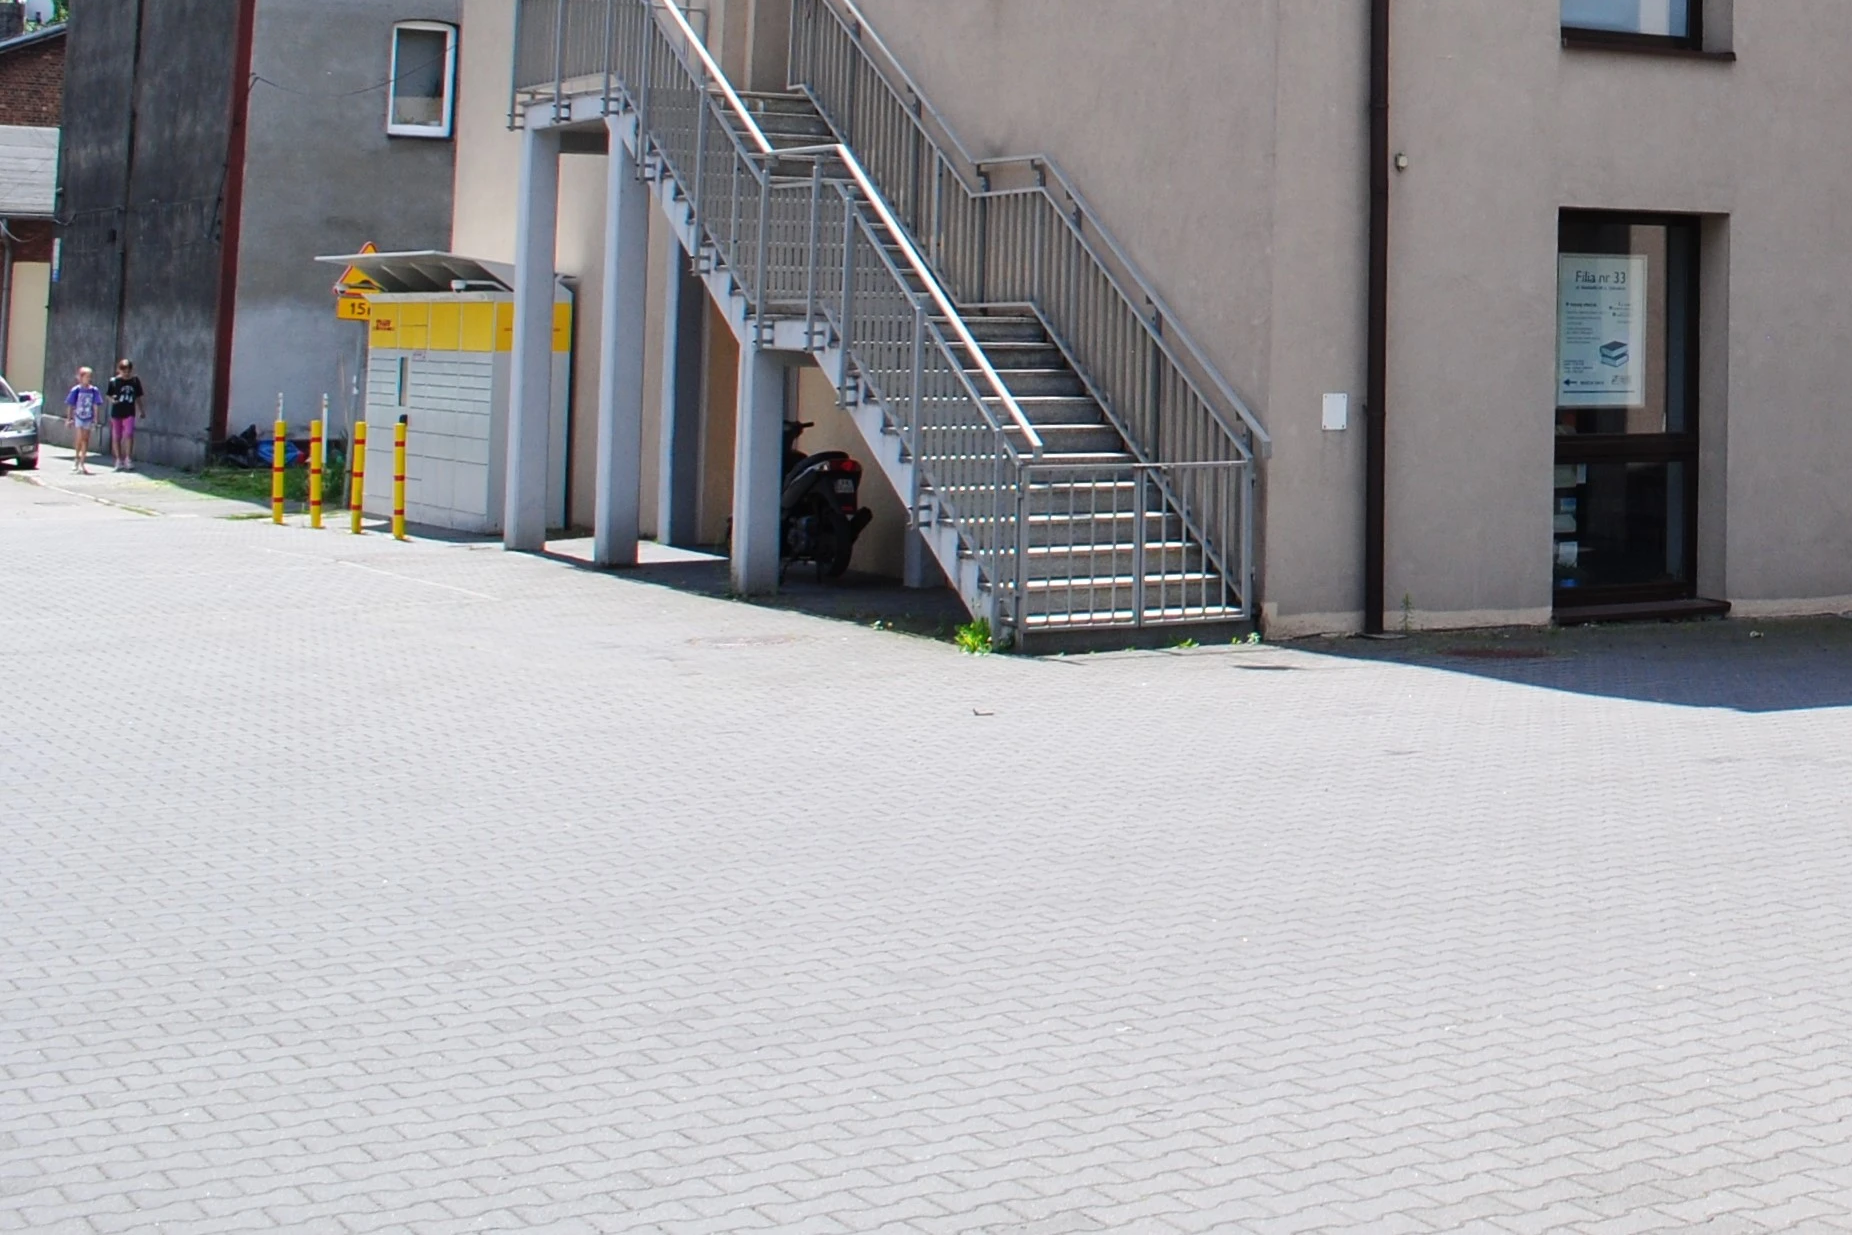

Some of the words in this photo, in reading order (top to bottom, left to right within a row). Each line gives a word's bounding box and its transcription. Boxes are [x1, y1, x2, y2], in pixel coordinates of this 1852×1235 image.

[1576, 270, 1596, 283] Filia
[1599, 274, 1610, 283] nr
[1613, 271, 1626, 284] 33
